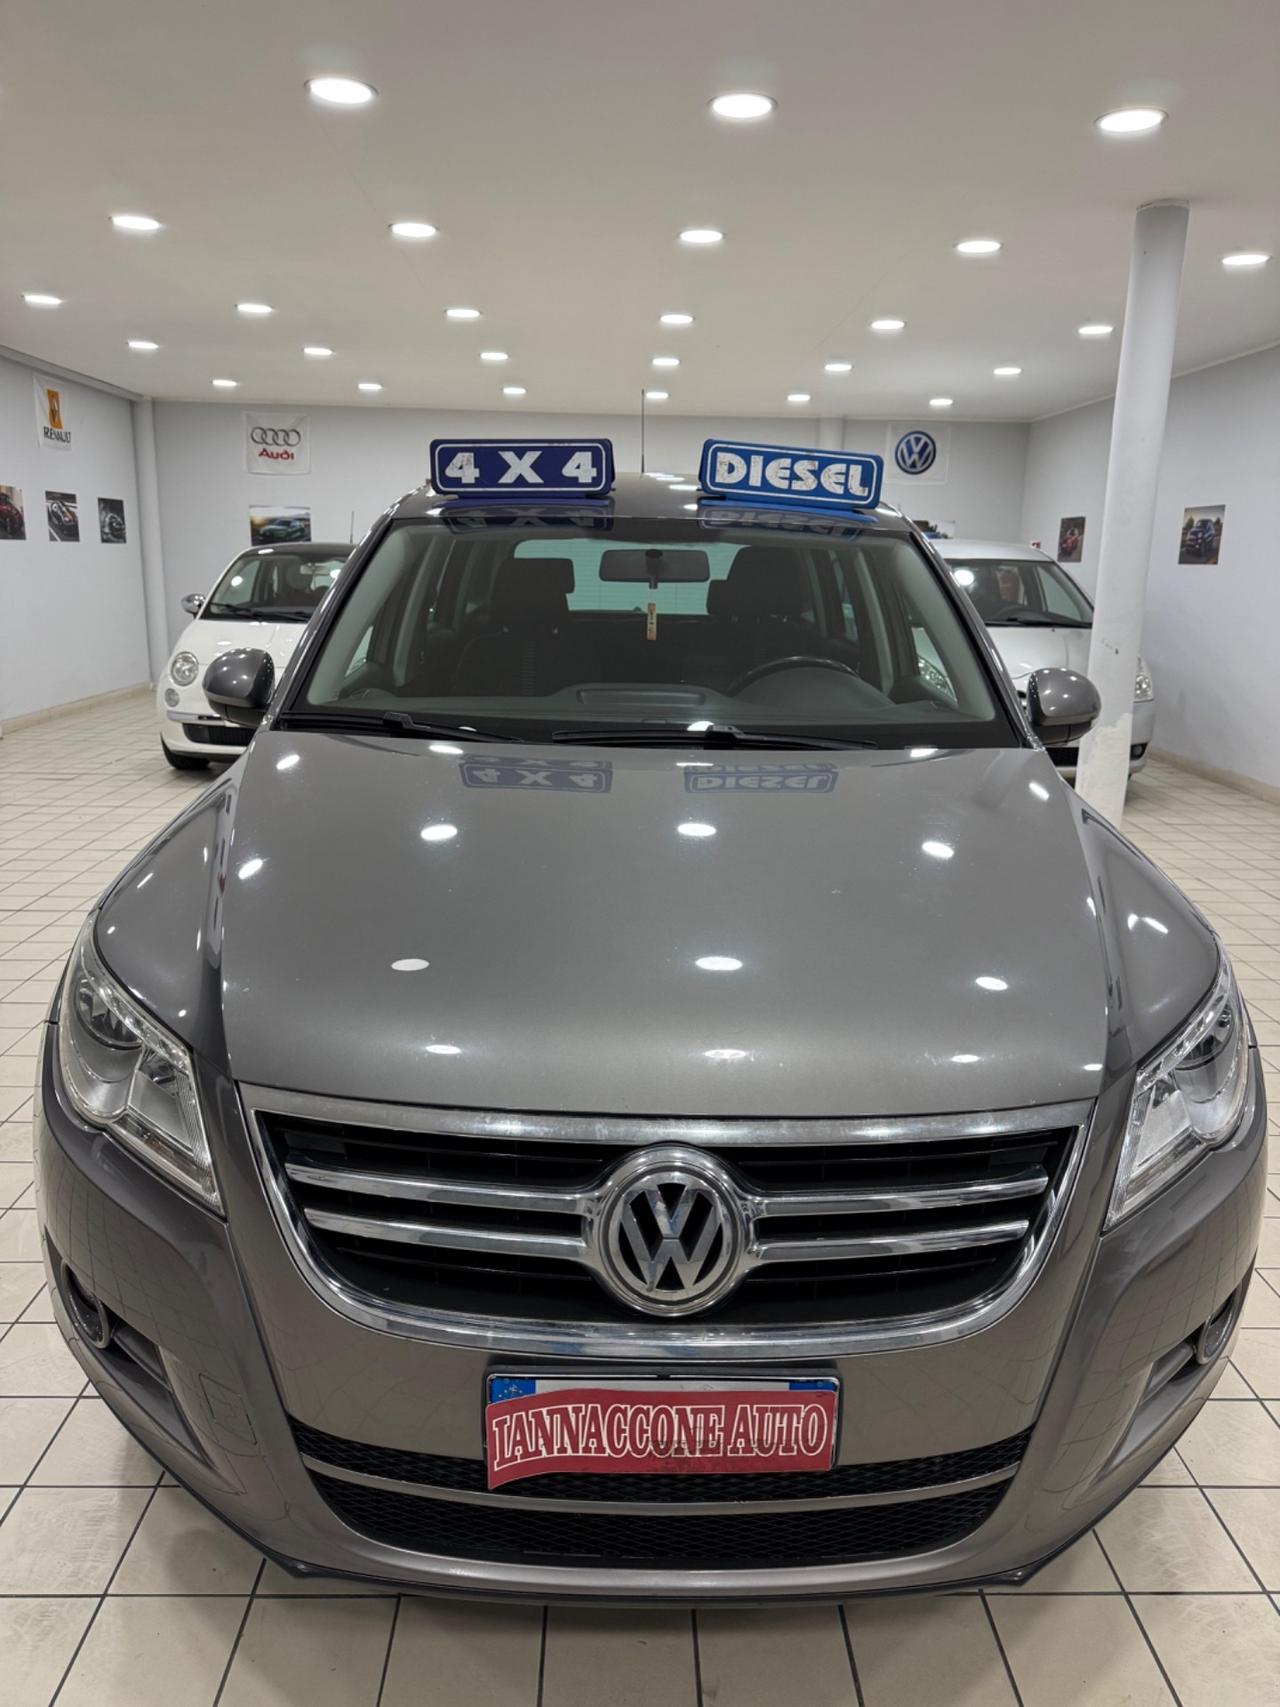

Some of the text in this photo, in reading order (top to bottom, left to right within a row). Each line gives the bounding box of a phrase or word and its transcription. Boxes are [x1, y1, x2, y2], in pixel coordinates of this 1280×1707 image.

[258, 448, 294, 460] Audi
[445, 451, 597, 484] 4 X 4
[715, 451, 869, 495] DIESEL
[897, 433, 934, 472] VW
[612, 1173, 727, 1298] VW
[493, 1404, 828, 1471] IANNACCONE AUTO
